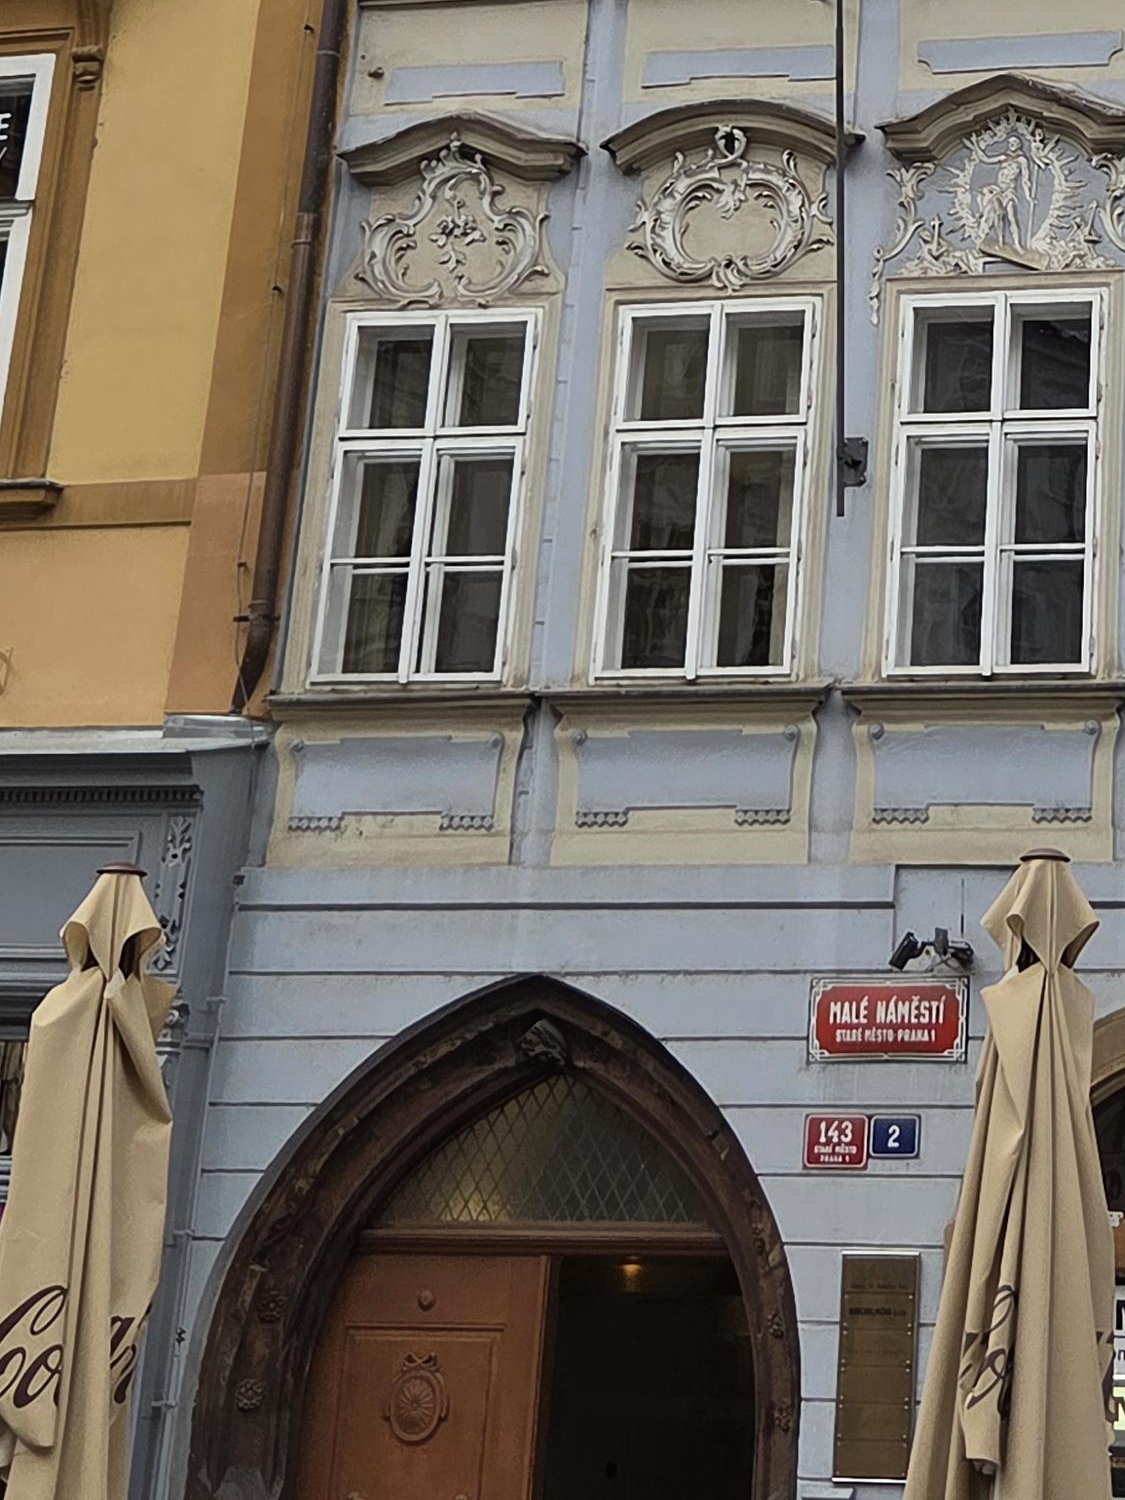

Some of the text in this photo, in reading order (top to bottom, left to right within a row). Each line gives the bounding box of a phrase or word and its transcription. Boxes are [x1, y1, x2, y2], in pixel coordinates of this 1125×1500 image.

[829, 995, 946, 1025] MALÉ NÁMĚSTÍ
[818, 1120, 853, 1143] 143
[887, 1124, 900, 1148] 2
